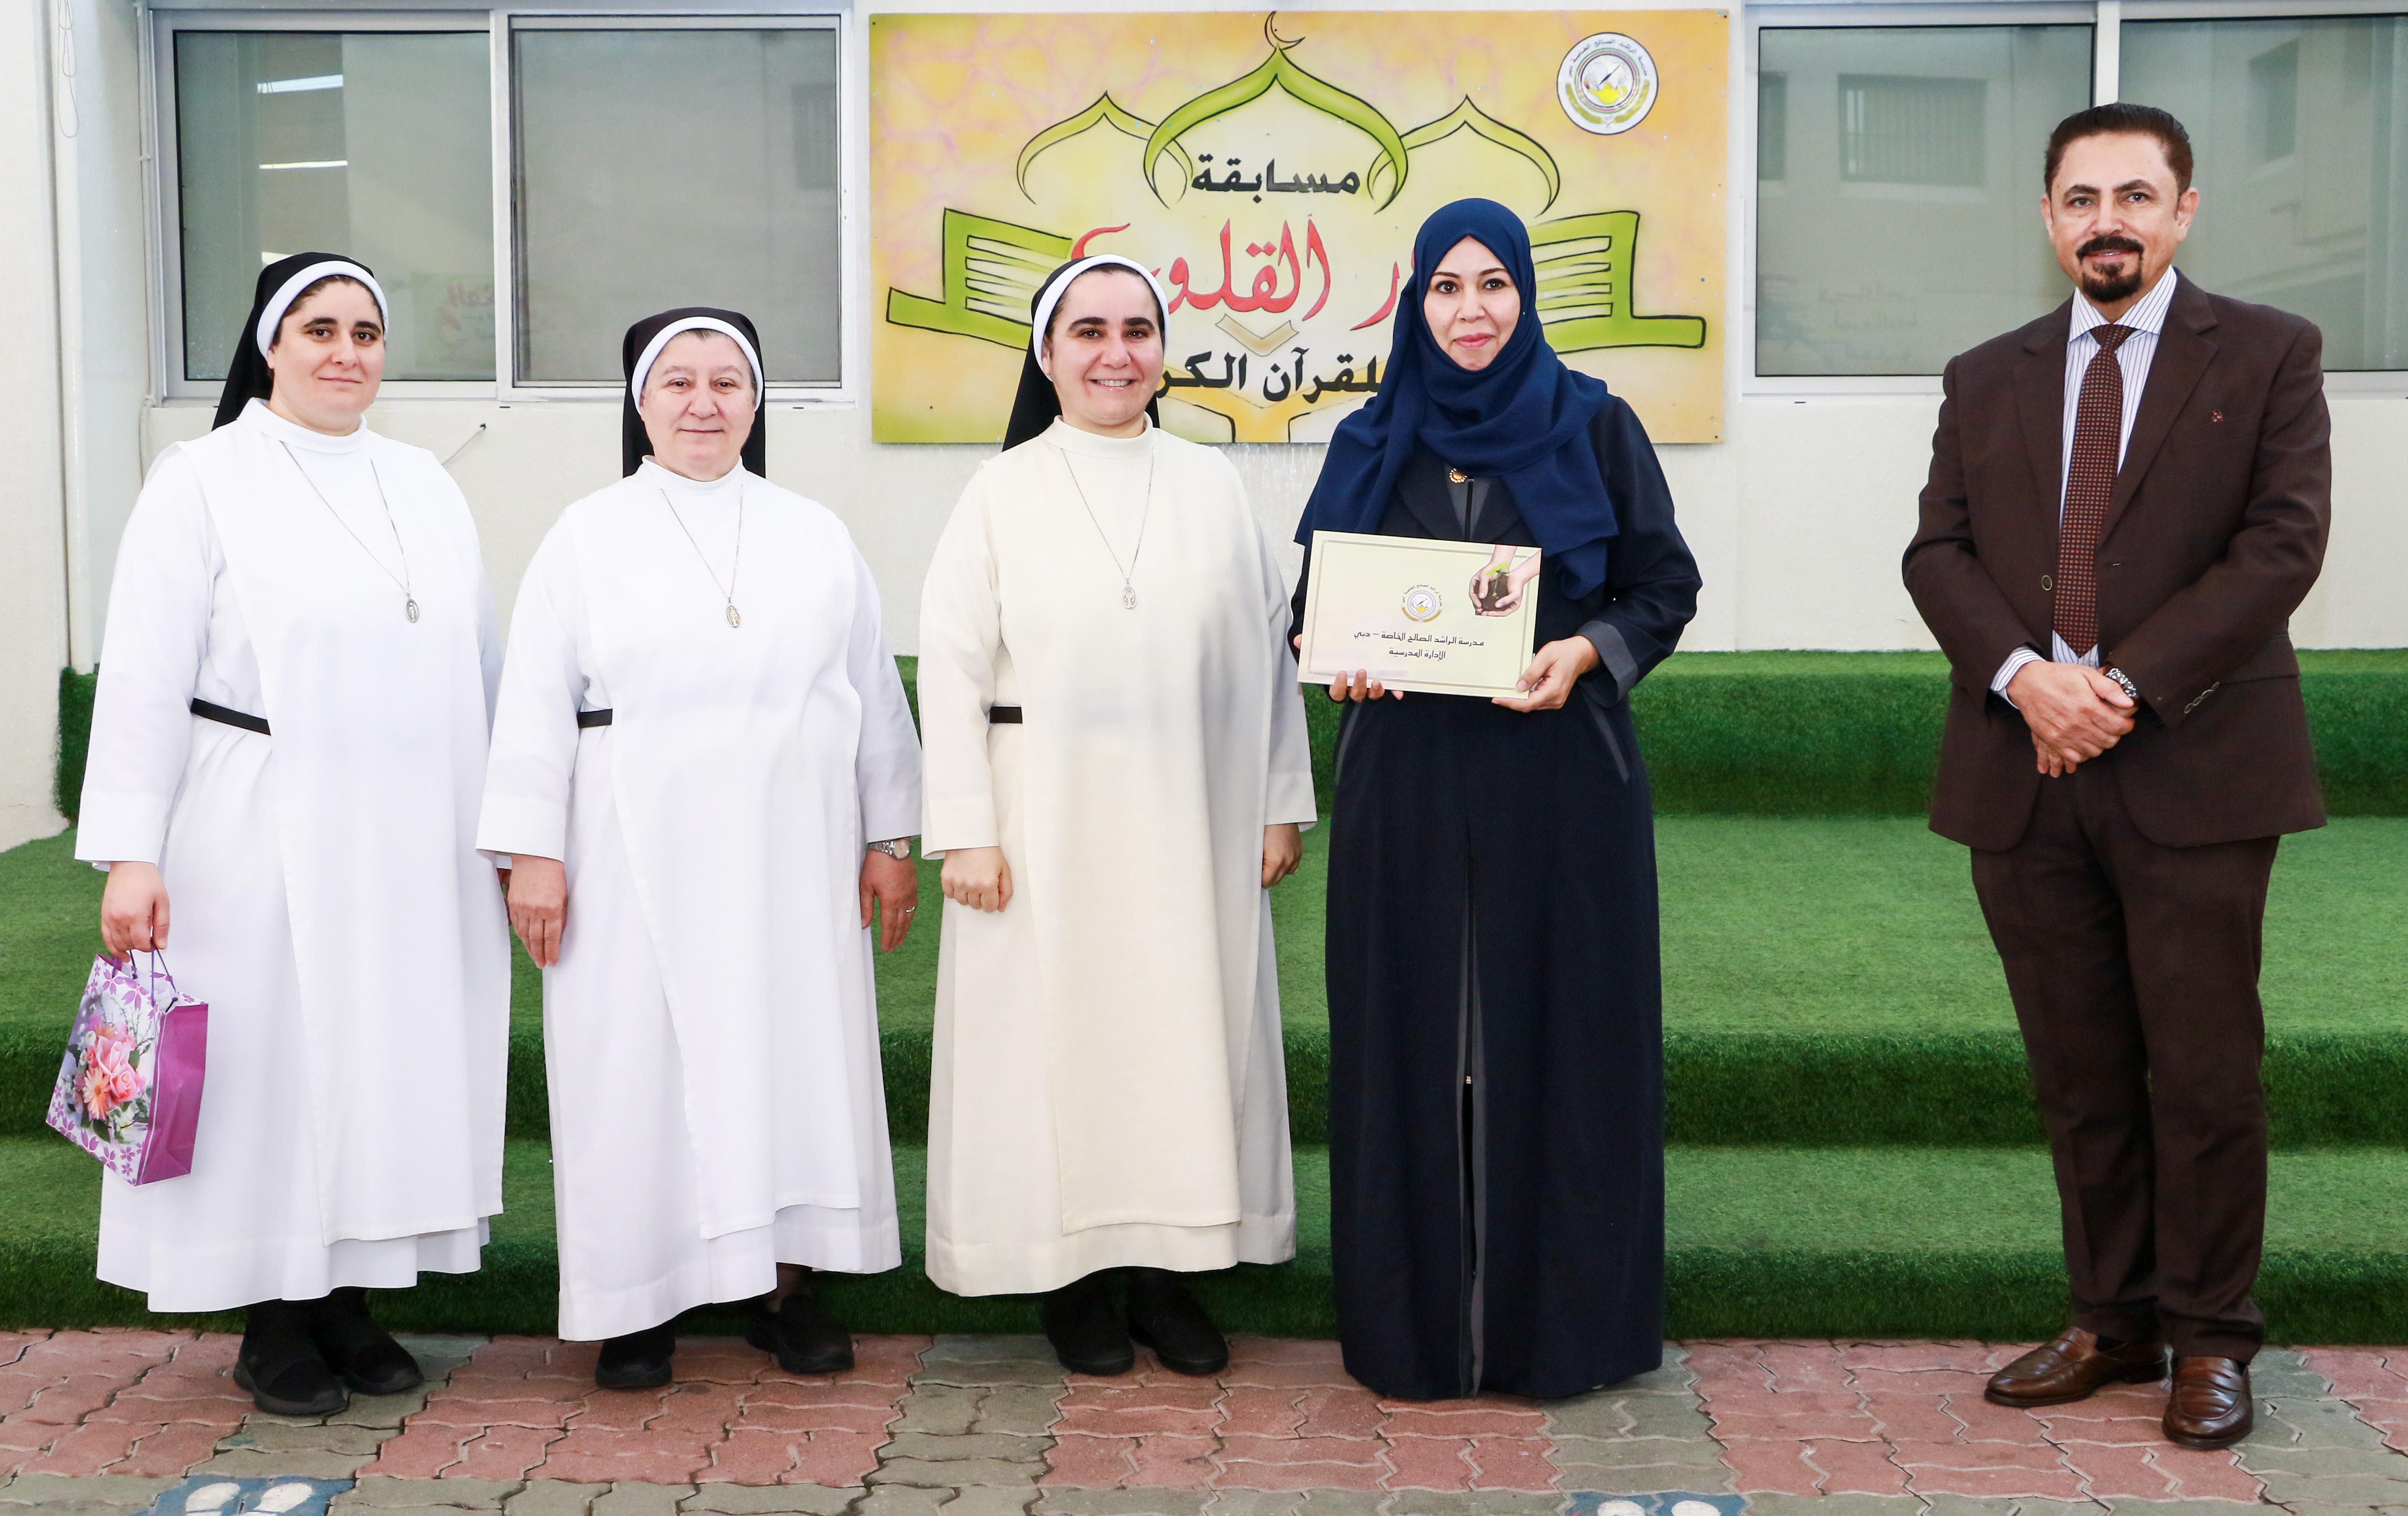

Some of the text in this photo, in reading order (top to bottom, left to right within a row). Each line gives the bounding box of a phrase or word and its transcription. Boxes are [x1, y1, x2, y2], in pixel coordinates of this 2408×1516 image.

[1191, 153, 1361, 203] مسابقة
[1155, 347, 1381, 404] لقرآن الكر
[1354, 631, 1370, 640] دبي
[1381, 631, 1406, 641] الخاصة
[1407, 633, 1432, 643] الصالح
[1434, 635, 1457, 646] الراشد
[1458, 637, 1484, 647] مدرسة
[1389, 647, 1446, 662] الإدارة المدرسية
